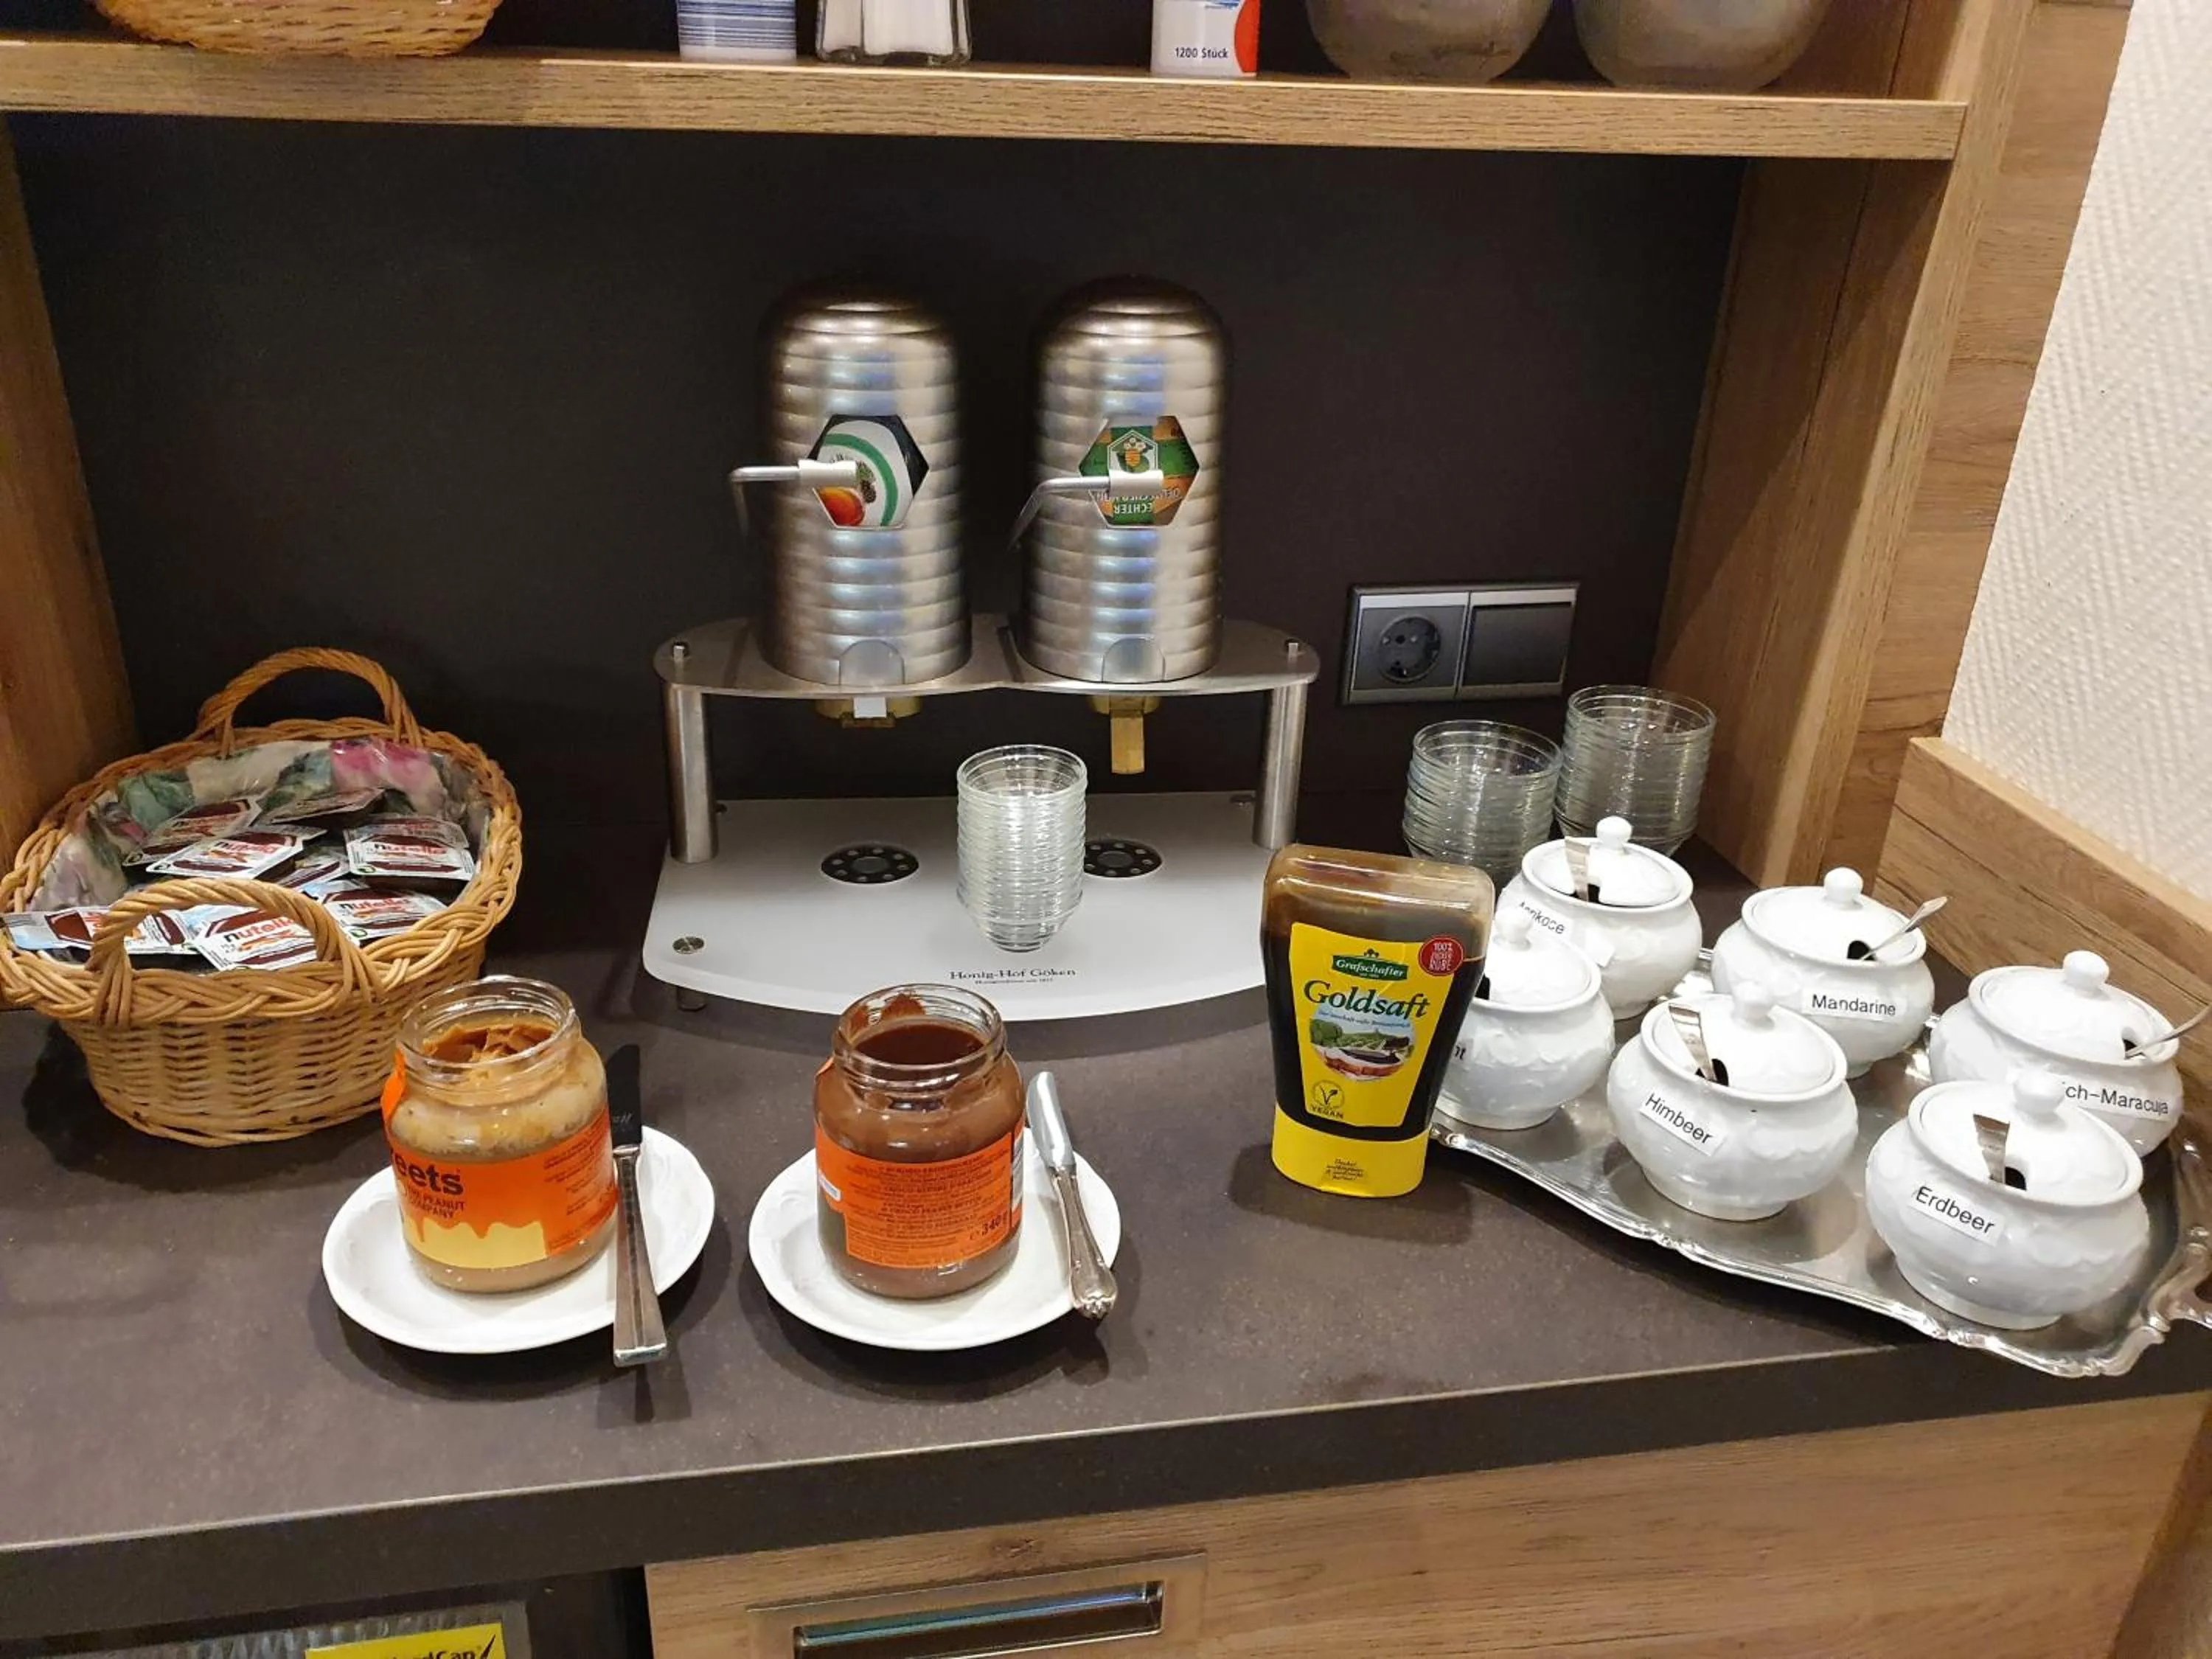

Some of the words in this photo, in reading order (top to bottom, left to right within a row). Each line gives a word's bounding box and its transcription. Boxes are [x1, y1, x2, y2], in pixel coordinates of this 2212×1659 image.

[1175, 46, 1198, 58] 1200
[1201, 46, 1228, 59] Stück
[1114, 503, 1152, 514] ECHTER
[374, 842, 448, 855] nutella
[340, 897, 412, 911] nutella
[1303, 979, 1431, 1020] Goldsaft
[1812, 993, 1896, 1016] Mandarine
[2062, 1081, 2169, 1116] ch-Maracuja
[1645, 1092, 1714, 1144] Himbeer
[1915, 1185, 1995, 1234] Erdbeer
